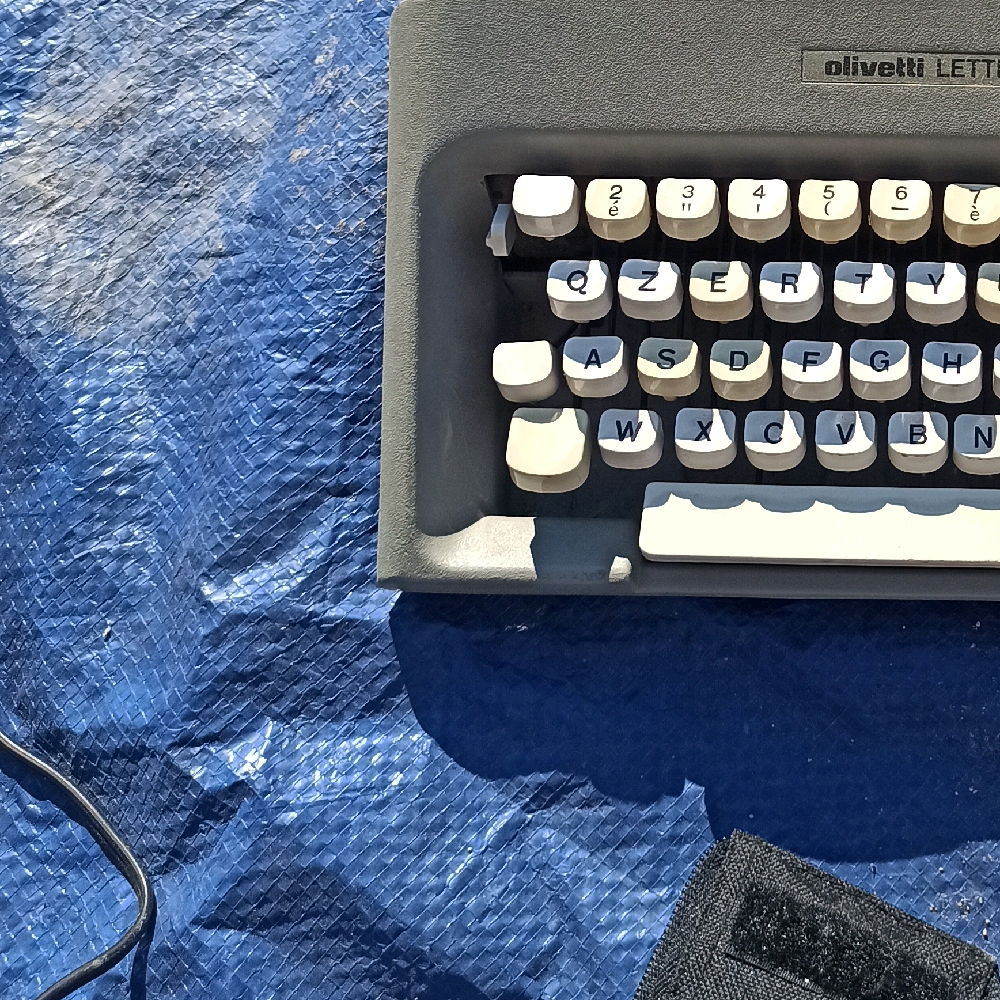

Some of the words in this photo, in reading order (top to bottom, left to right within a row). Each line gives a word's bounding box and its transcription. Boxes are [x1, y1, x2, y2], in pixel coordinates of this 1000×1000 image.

[824, 55, 924, 79] olivetti
[608, 184, 623, 200] 2
[682, 185, 695, 199] 3
[752, 184, 767, 199] 4
[822, 184, 836, 200] 5
[895, 185, 908, 200] 6
[608, 200, 619, 217] é
[566, 269, 588, 296] Q
[638, 270, 660, 292] Z
[709, 270, 728, 293] E
[780, 272, 800, 295] R
[854, 272, 874, 294] T
[926, 272, 946, 295] Y
[583, 348, 602, 370] A
[656, 347, 677, 370] S
[729, 350, 749, 372] D
[802, 350, 821, 373] F
[869, 349, 890, 373] G
[943, 353, 962, 374] H
[615, 420, 643, 442] W
[696, 420, 714, 442] X
[763, 421, 784, 445] C
[835, 423, 856, 446] V
[909, 424, 929, 446] B
[974, 426, 993, 449] N
